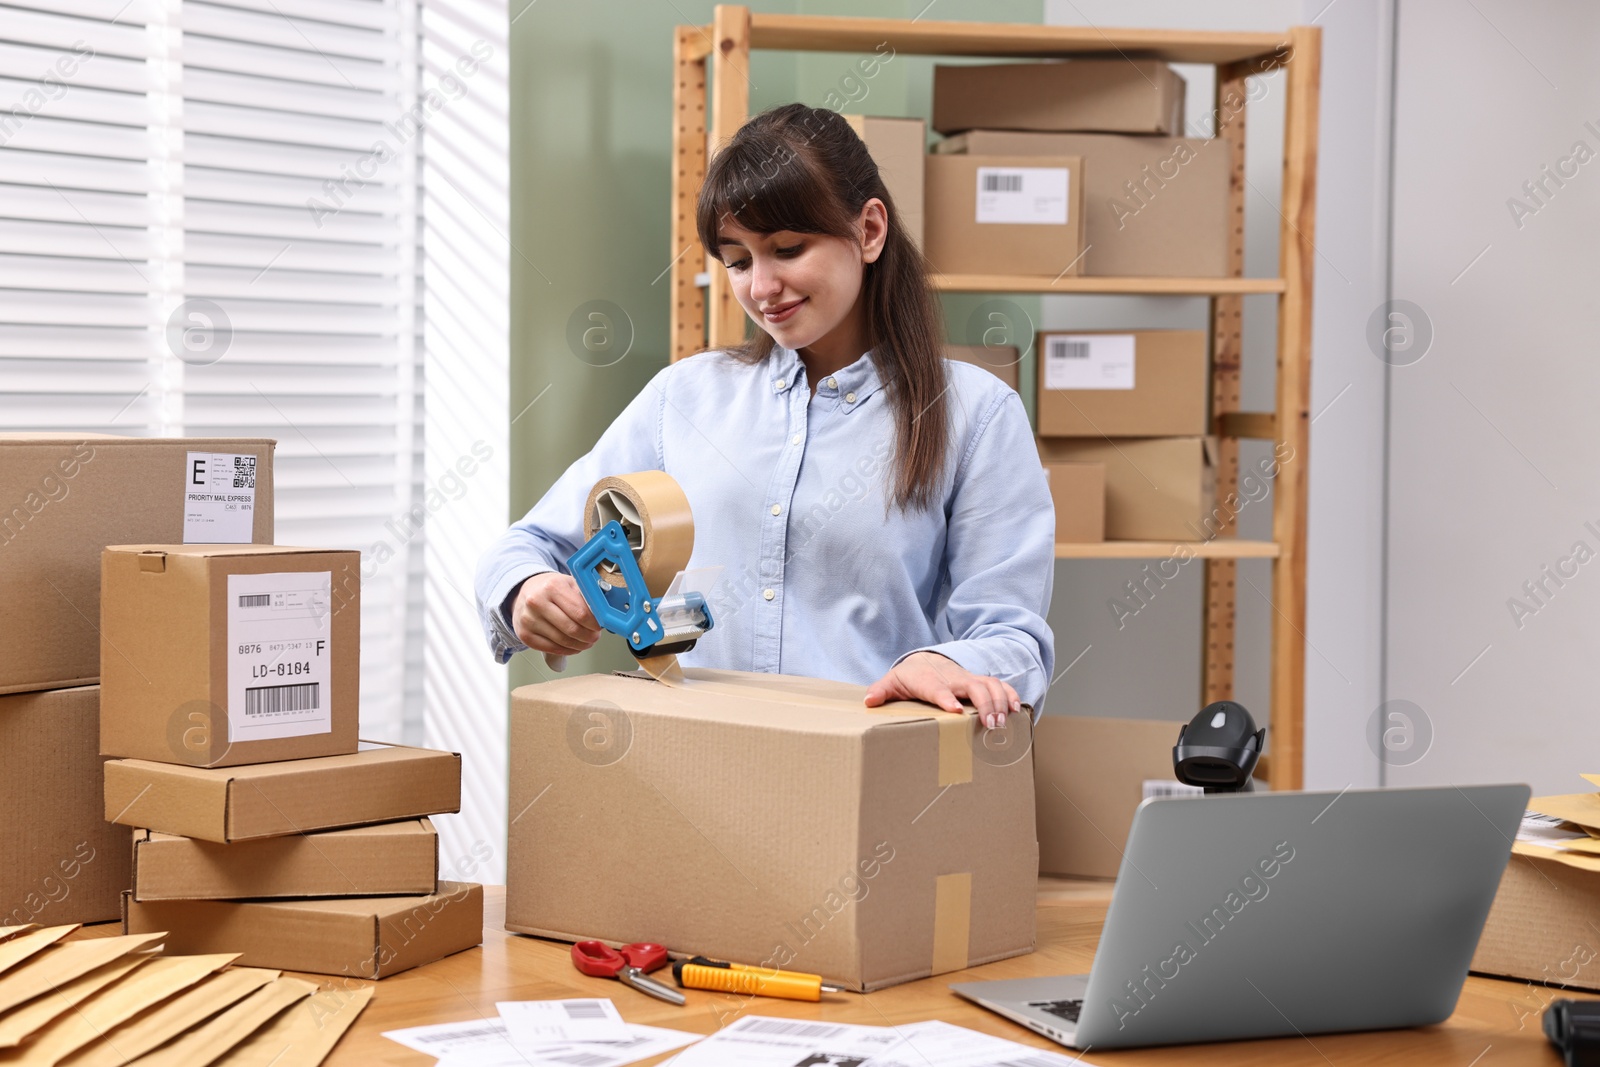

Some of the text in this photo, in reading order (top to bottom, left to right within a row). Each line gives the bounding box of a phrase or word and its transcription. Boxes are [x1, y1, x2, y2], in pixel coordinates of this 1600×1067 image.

[193, 460, 205, 484] E
[228, 495, 251, 503] EXPRESS
[238, 644, 262, 655] 0876
[316, 640, 325, 656] F
[252, 661, 311, 678] LD-0104
